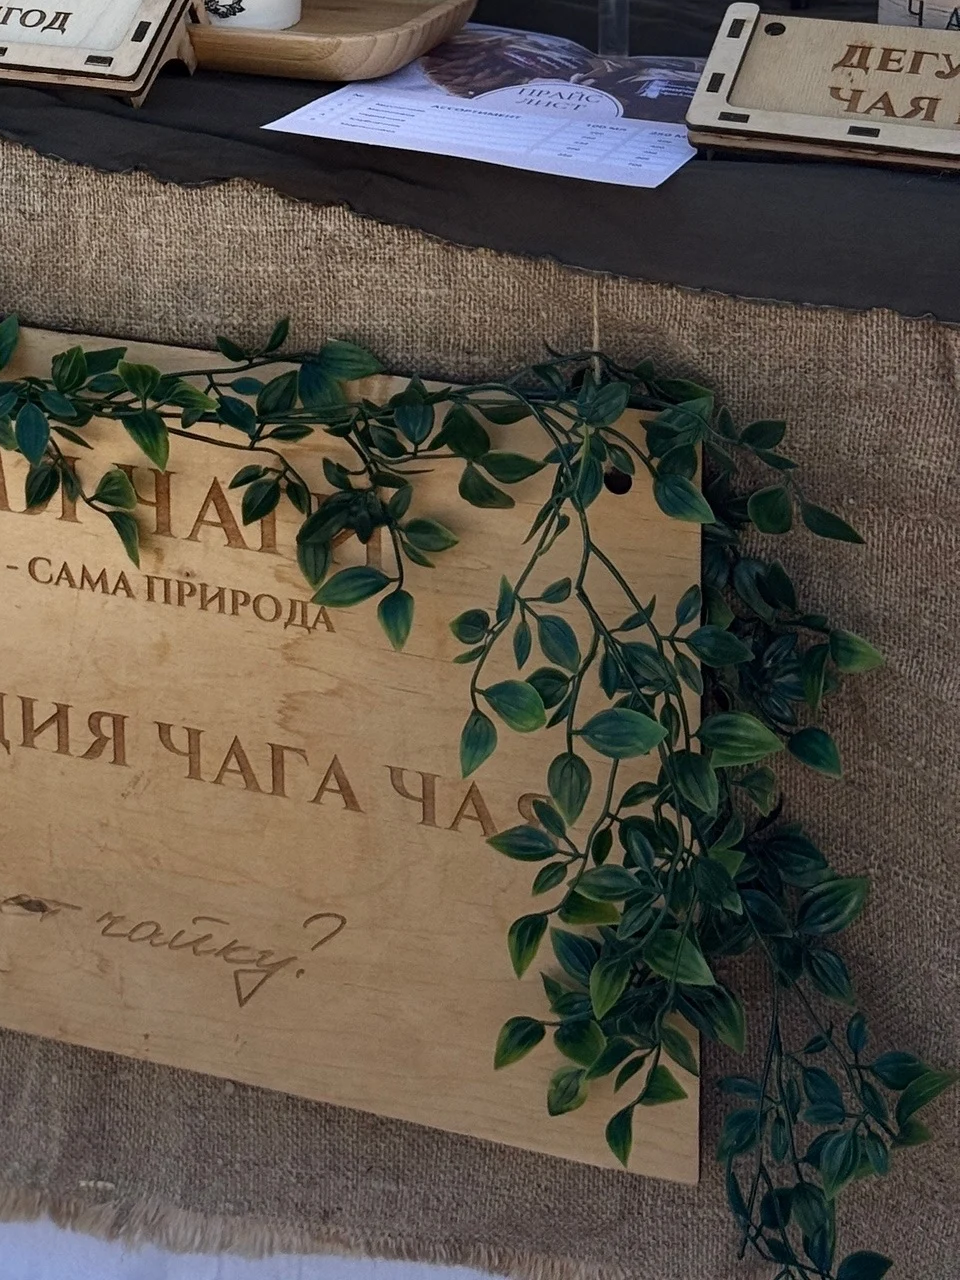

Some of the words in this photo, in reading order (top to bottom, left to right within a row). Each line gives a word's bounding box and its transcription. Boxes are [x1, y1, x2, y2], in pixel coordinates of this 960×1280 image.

[515, 97, 587, 112] ЛИСТ
[518, 87, 604, 105] ПРАЙС
[828, 86, 943, 123] ЧАЯ
[27, 555, 138, 600] САМА
[142, 574, 337, 634] ПРИРОДА
[153, 720, 368, 815] ЧАГА
